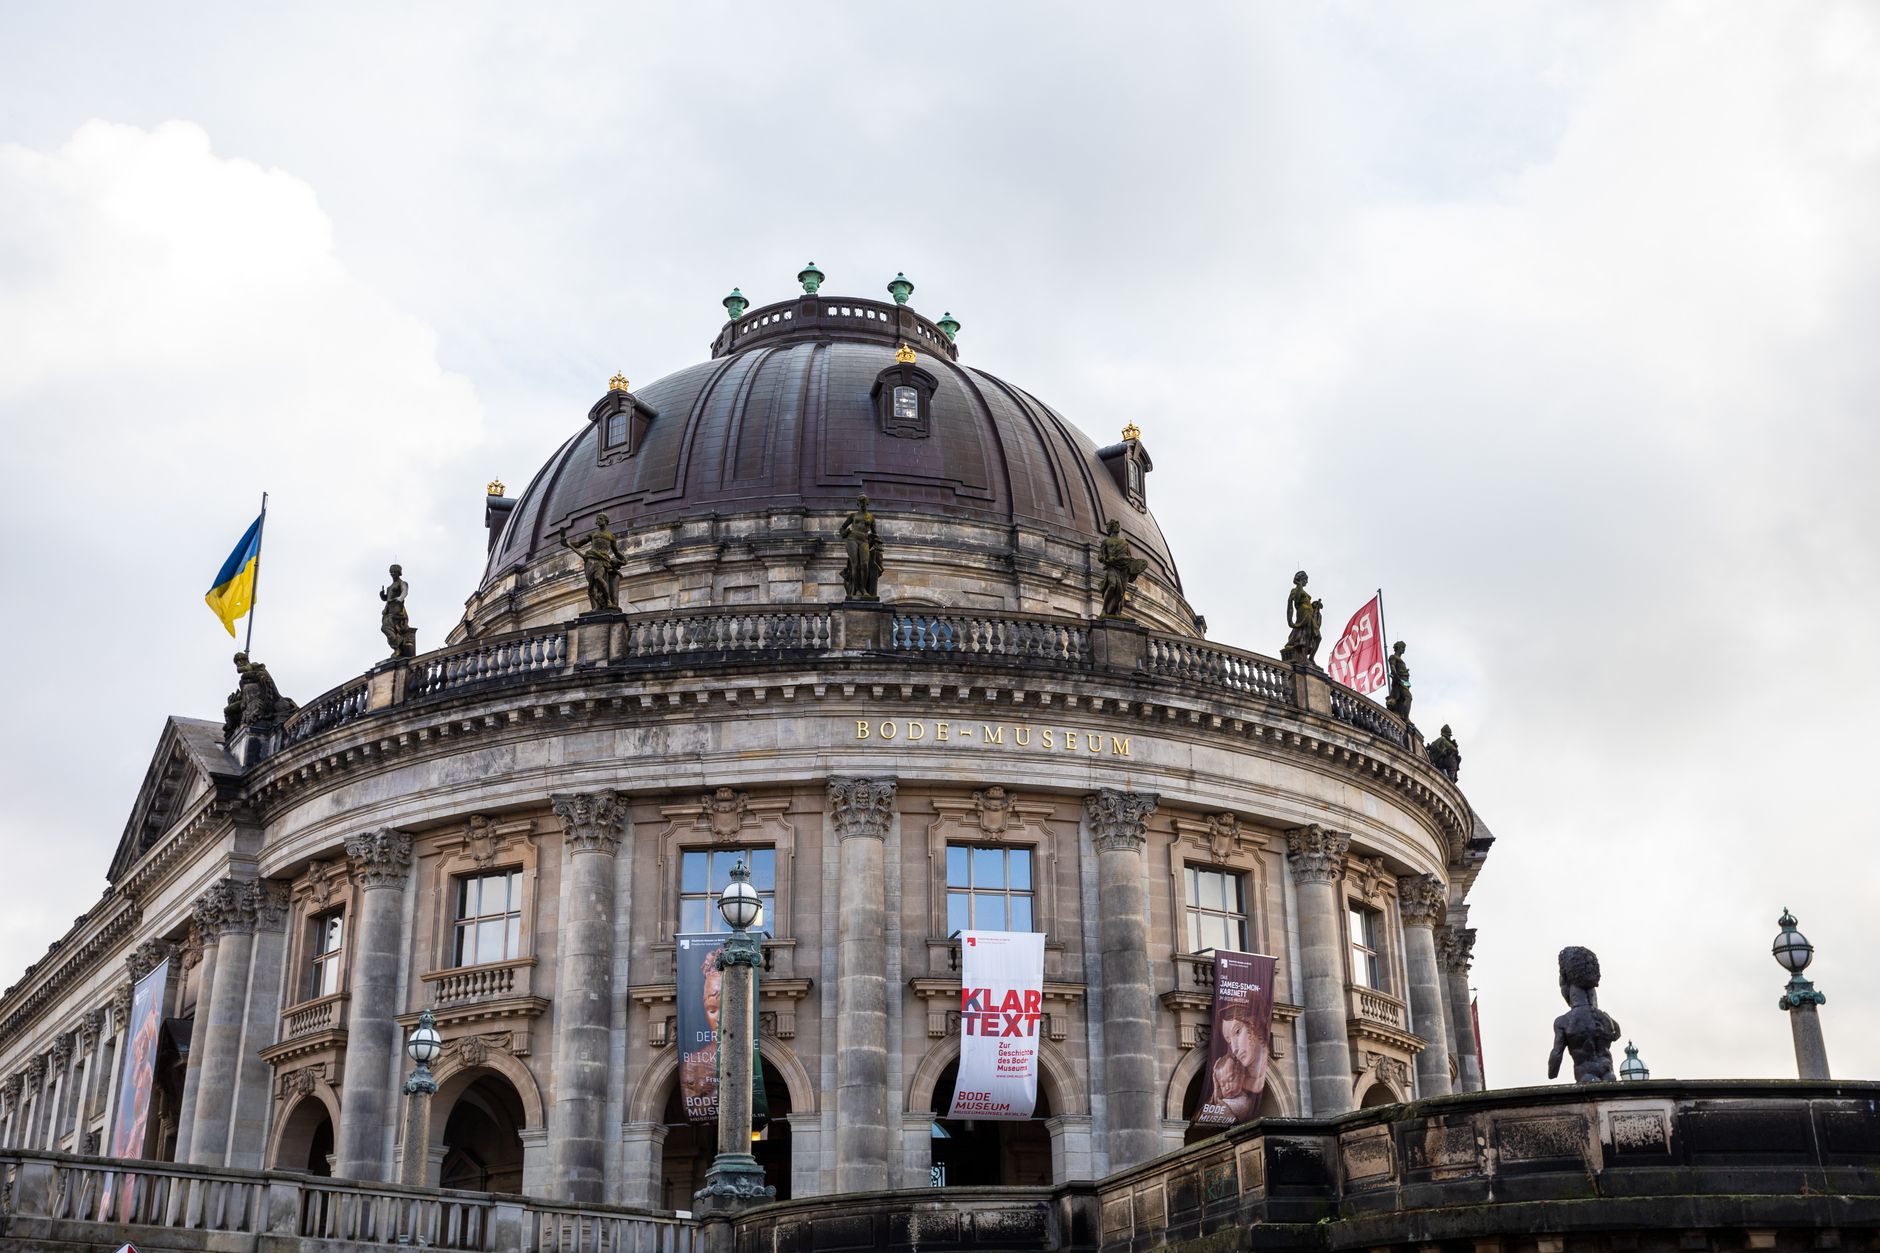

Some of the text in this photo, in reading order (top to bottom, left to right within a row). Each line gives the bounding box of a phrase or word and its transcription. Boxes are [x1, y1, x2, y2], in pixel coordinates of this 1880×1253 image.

[1219, 980, 1261, 991] JAMES-SIMON-
[1219, 988, 1247, 997] KABINETT
[962, 988, 1041, 1013] KLAR
[961, 1012, 1041, 1038] TEXT
[696, 1031, 718, 1042] DER
[683, 1052, 717, 1063] BLICK
[686, 1096, 719, 1107] BODE
[958, 1091, 991, 1101] BODE
[955, 1102, 1010, 1111] MUSEUM
[1203, 1104, 1226, 1115] BODE
[1198, 1114, 1236, 1124] MUSEUM
